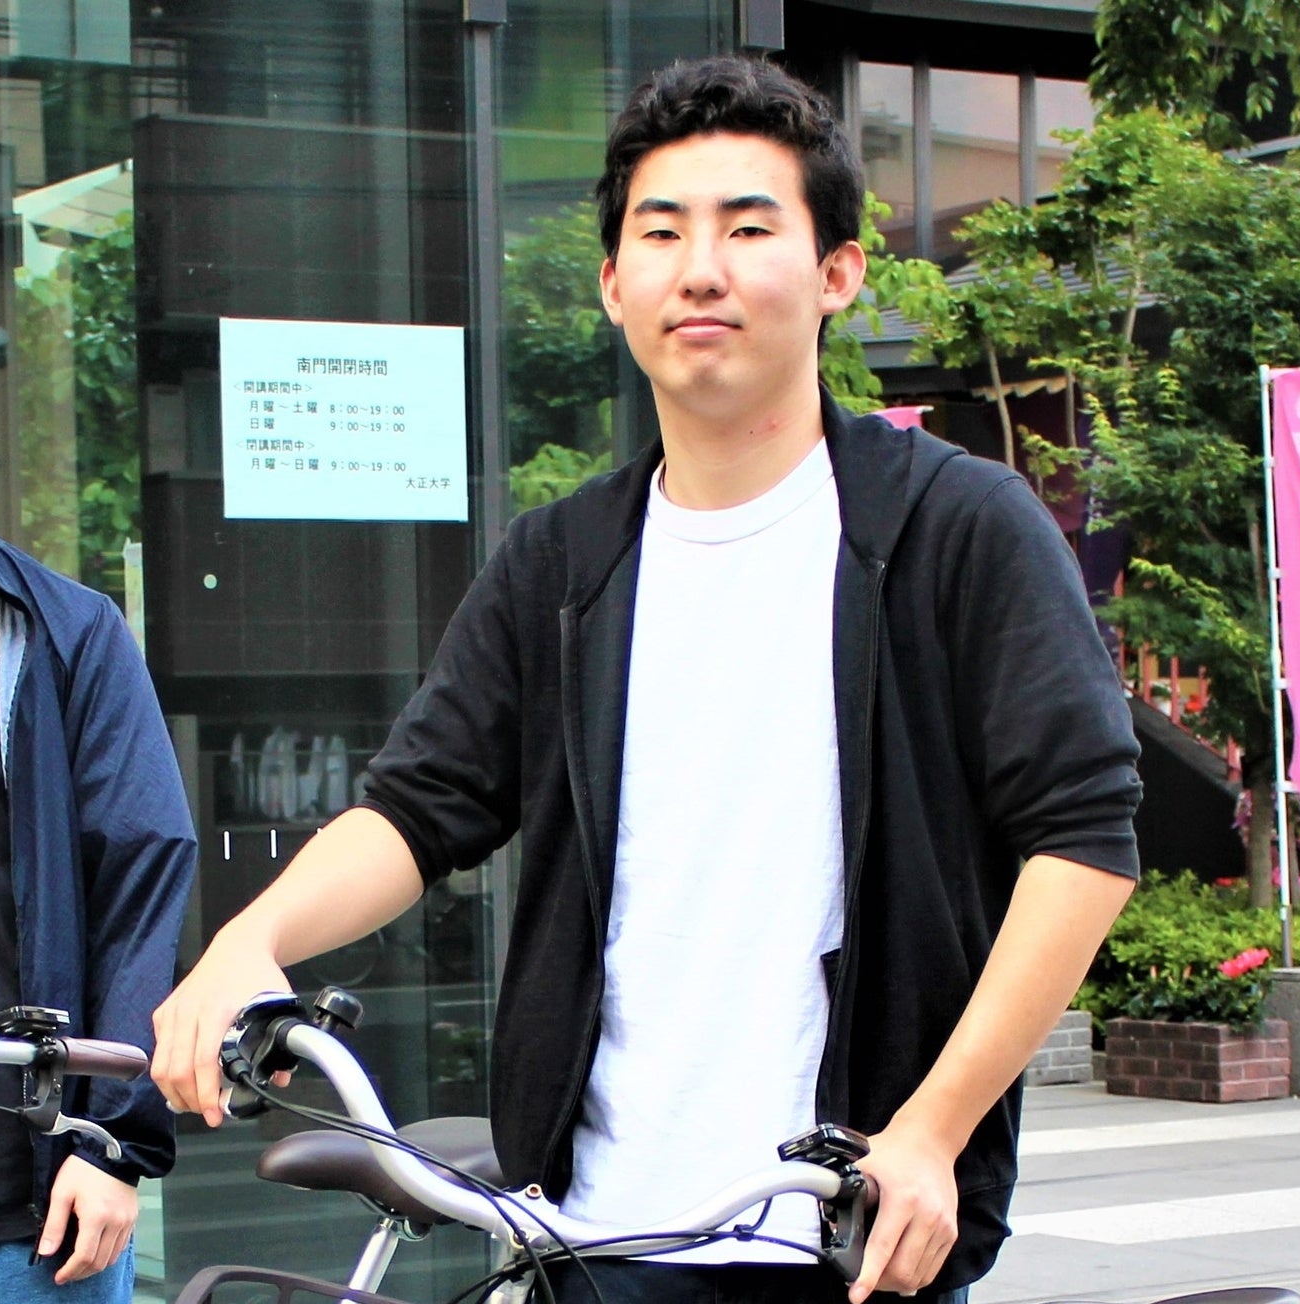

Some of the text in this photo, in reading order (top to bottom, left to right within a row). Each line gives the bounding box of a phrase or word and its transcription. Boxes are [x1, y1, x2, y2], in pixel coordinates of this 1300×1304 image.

[297, 357, 388, 376] 南門開閉時間
[406, 476, 451, 489] 大正大学
